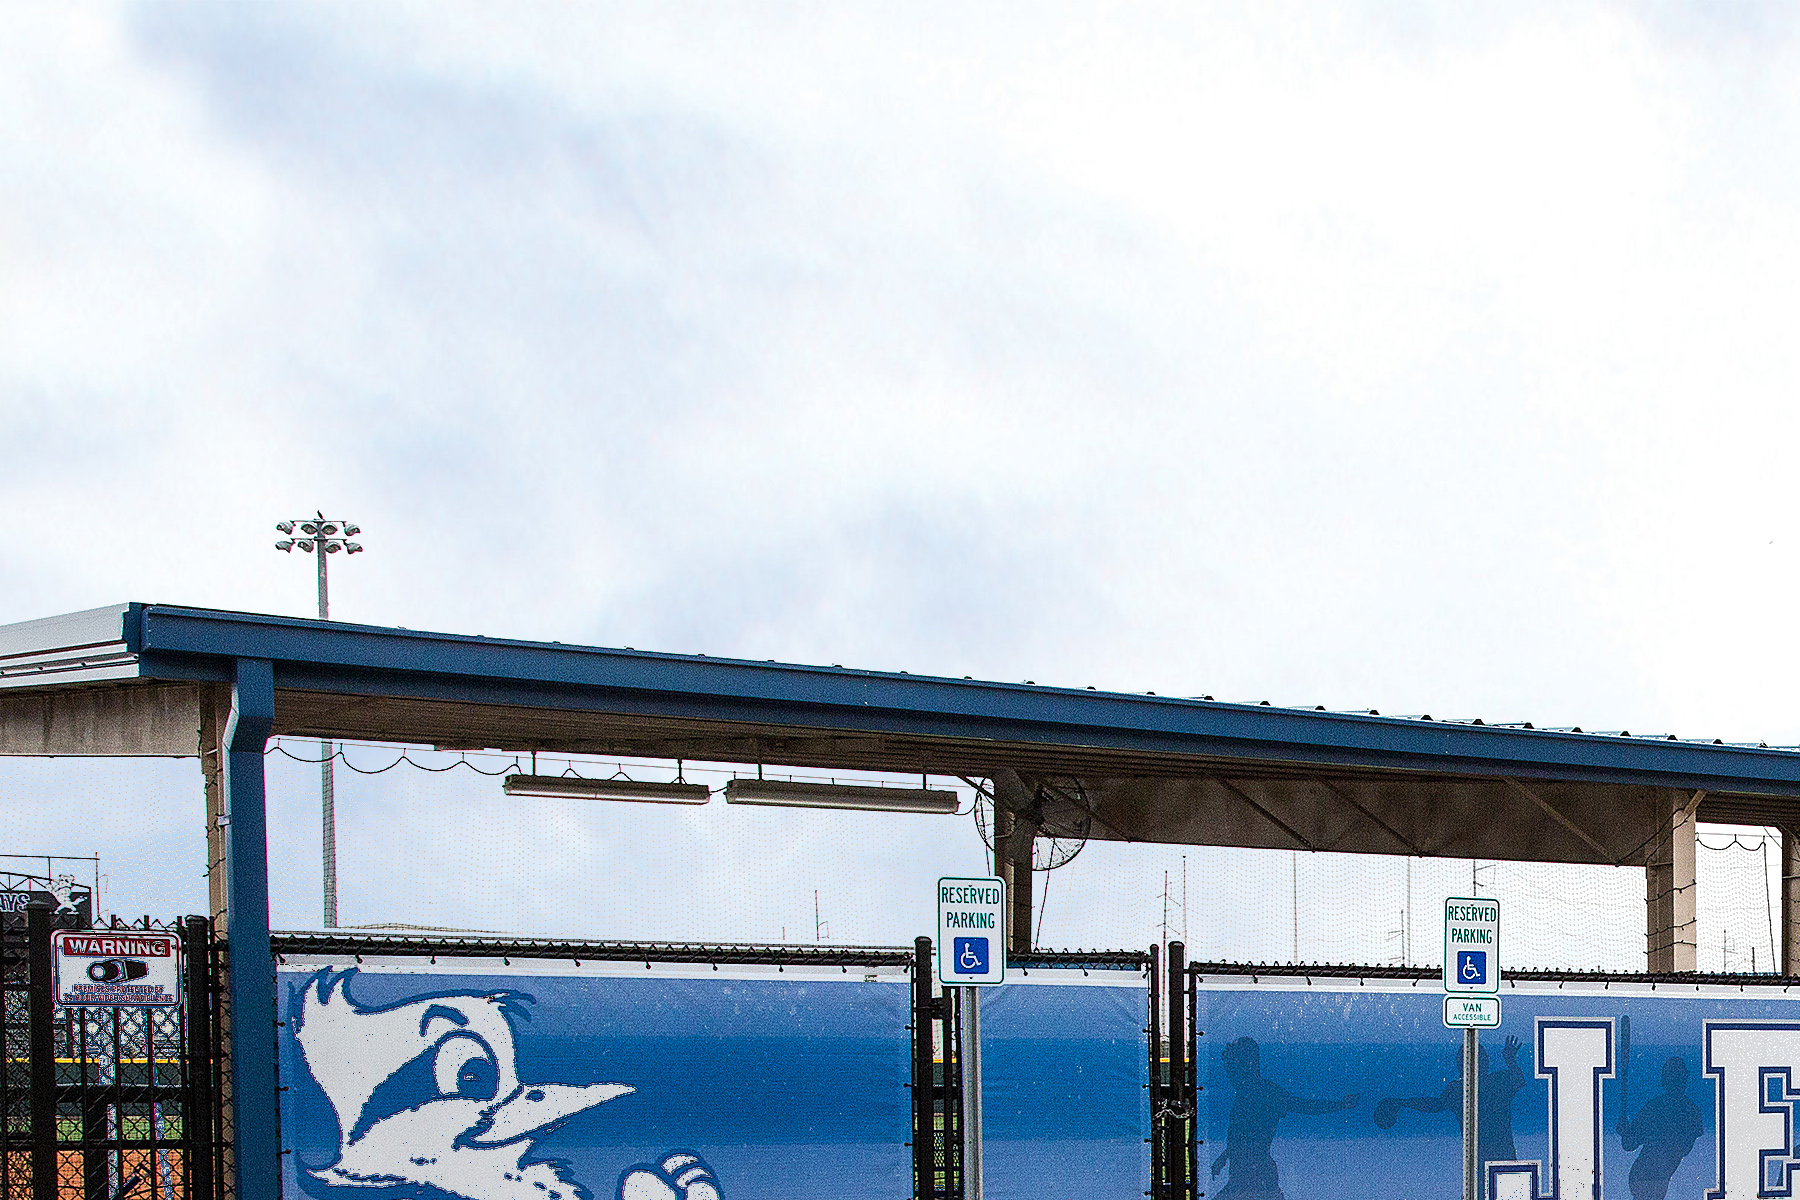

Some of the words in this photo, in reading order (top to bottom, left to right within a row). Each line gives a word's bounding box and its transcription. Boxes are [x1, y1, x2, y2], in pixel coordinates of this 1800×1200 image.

[941, 887, 1000, 905] RESERVED
[946, 912, 995, 929] PARKING
[1448, 906, 1497, 922] RESERVED
[1451, 928, 1493, 944] PARKING
[68, 939, 166, 956] WARNING
[73, 985, 109, 993] PREMISES
[112, 985, 153, 993] PROTECTED
[154, 985, 165, 993] BY
[75, 993, 96, 1001] HOUR
[98, 993, 119, 1001] VIDEO
[121, 994, 173, 1002] SURVEILLANCE
[1463, 1003, 1482, 1012] VAN
